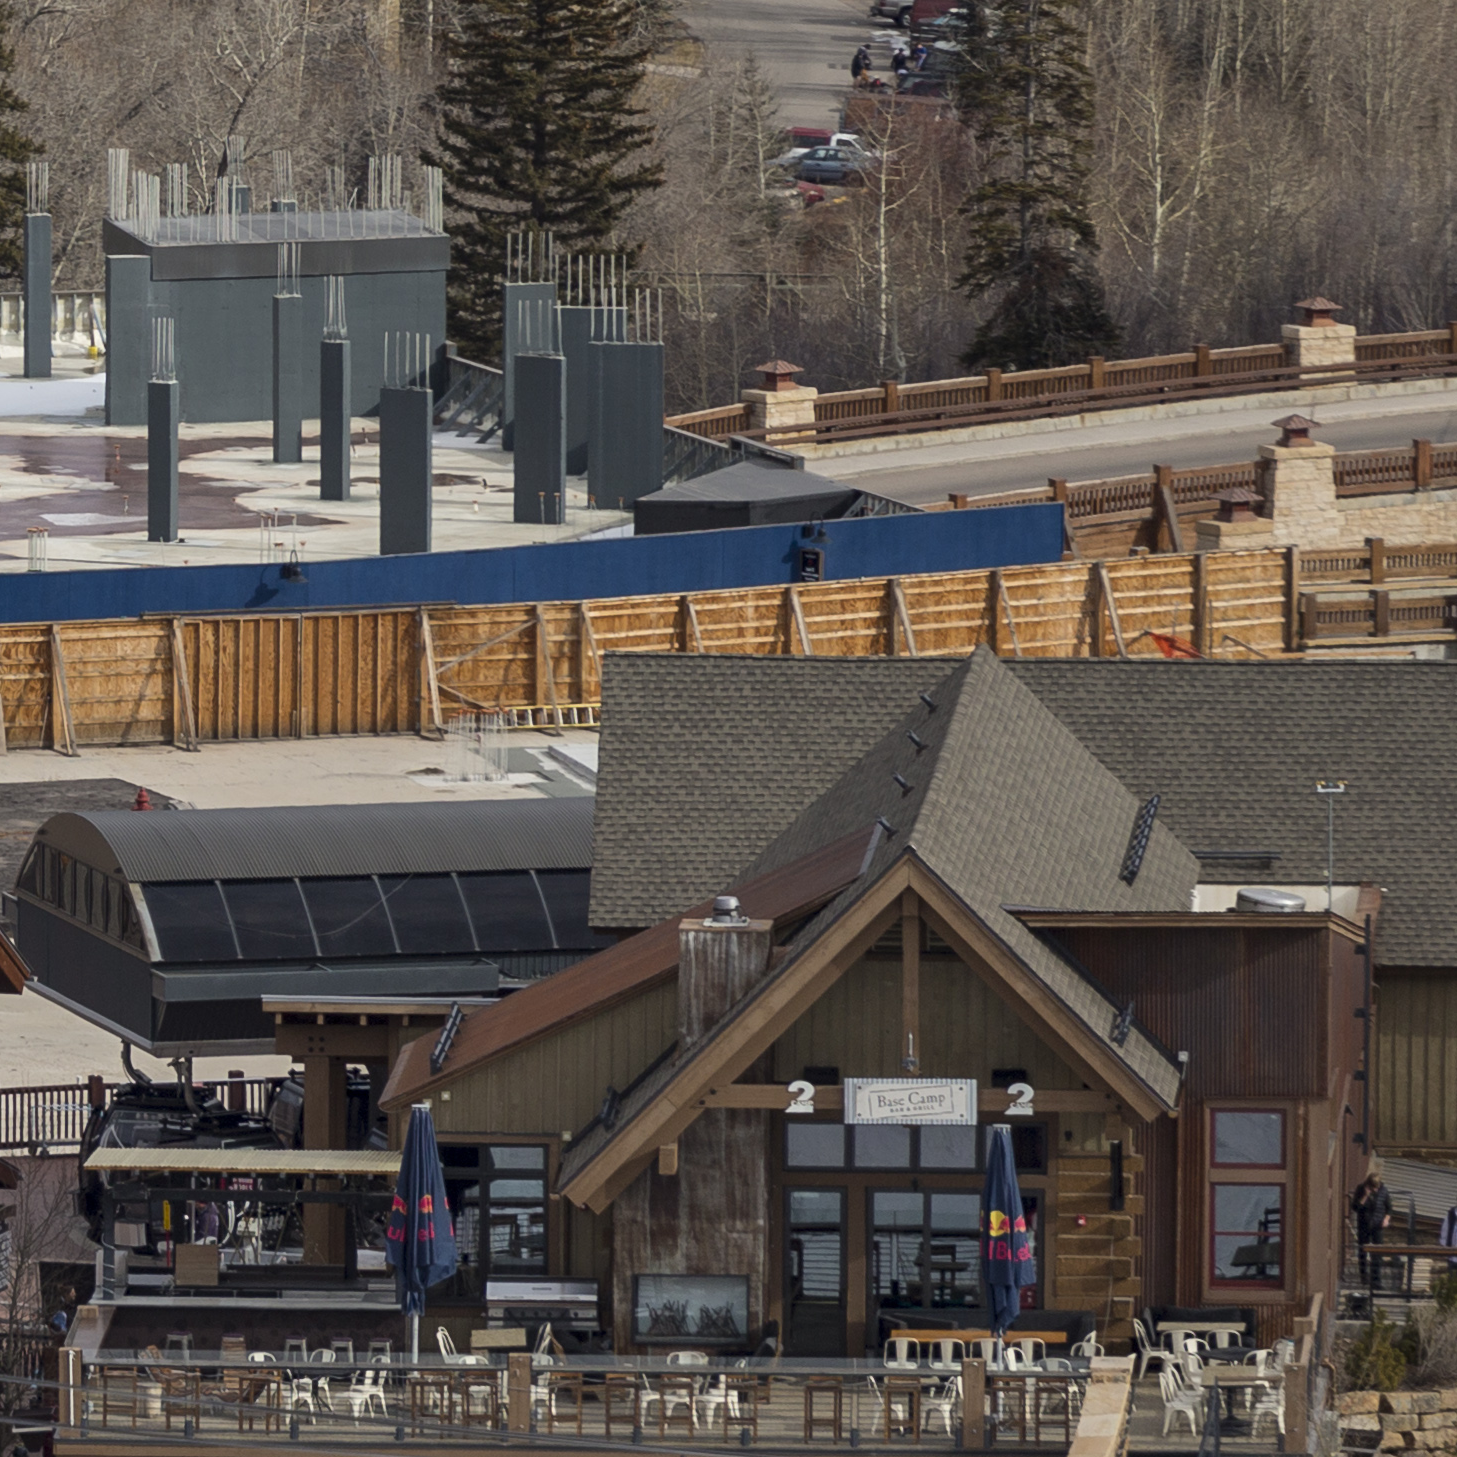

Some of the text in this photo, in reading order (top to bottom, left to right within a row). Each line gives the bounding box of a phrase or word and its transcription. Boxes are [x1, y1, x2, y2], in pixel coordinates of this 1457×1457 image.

[785, 1080, 815, 1113] 2
[878, 1091, 946, 1109] Base Camp
[1004, 1083, 1034, 1115] 2
